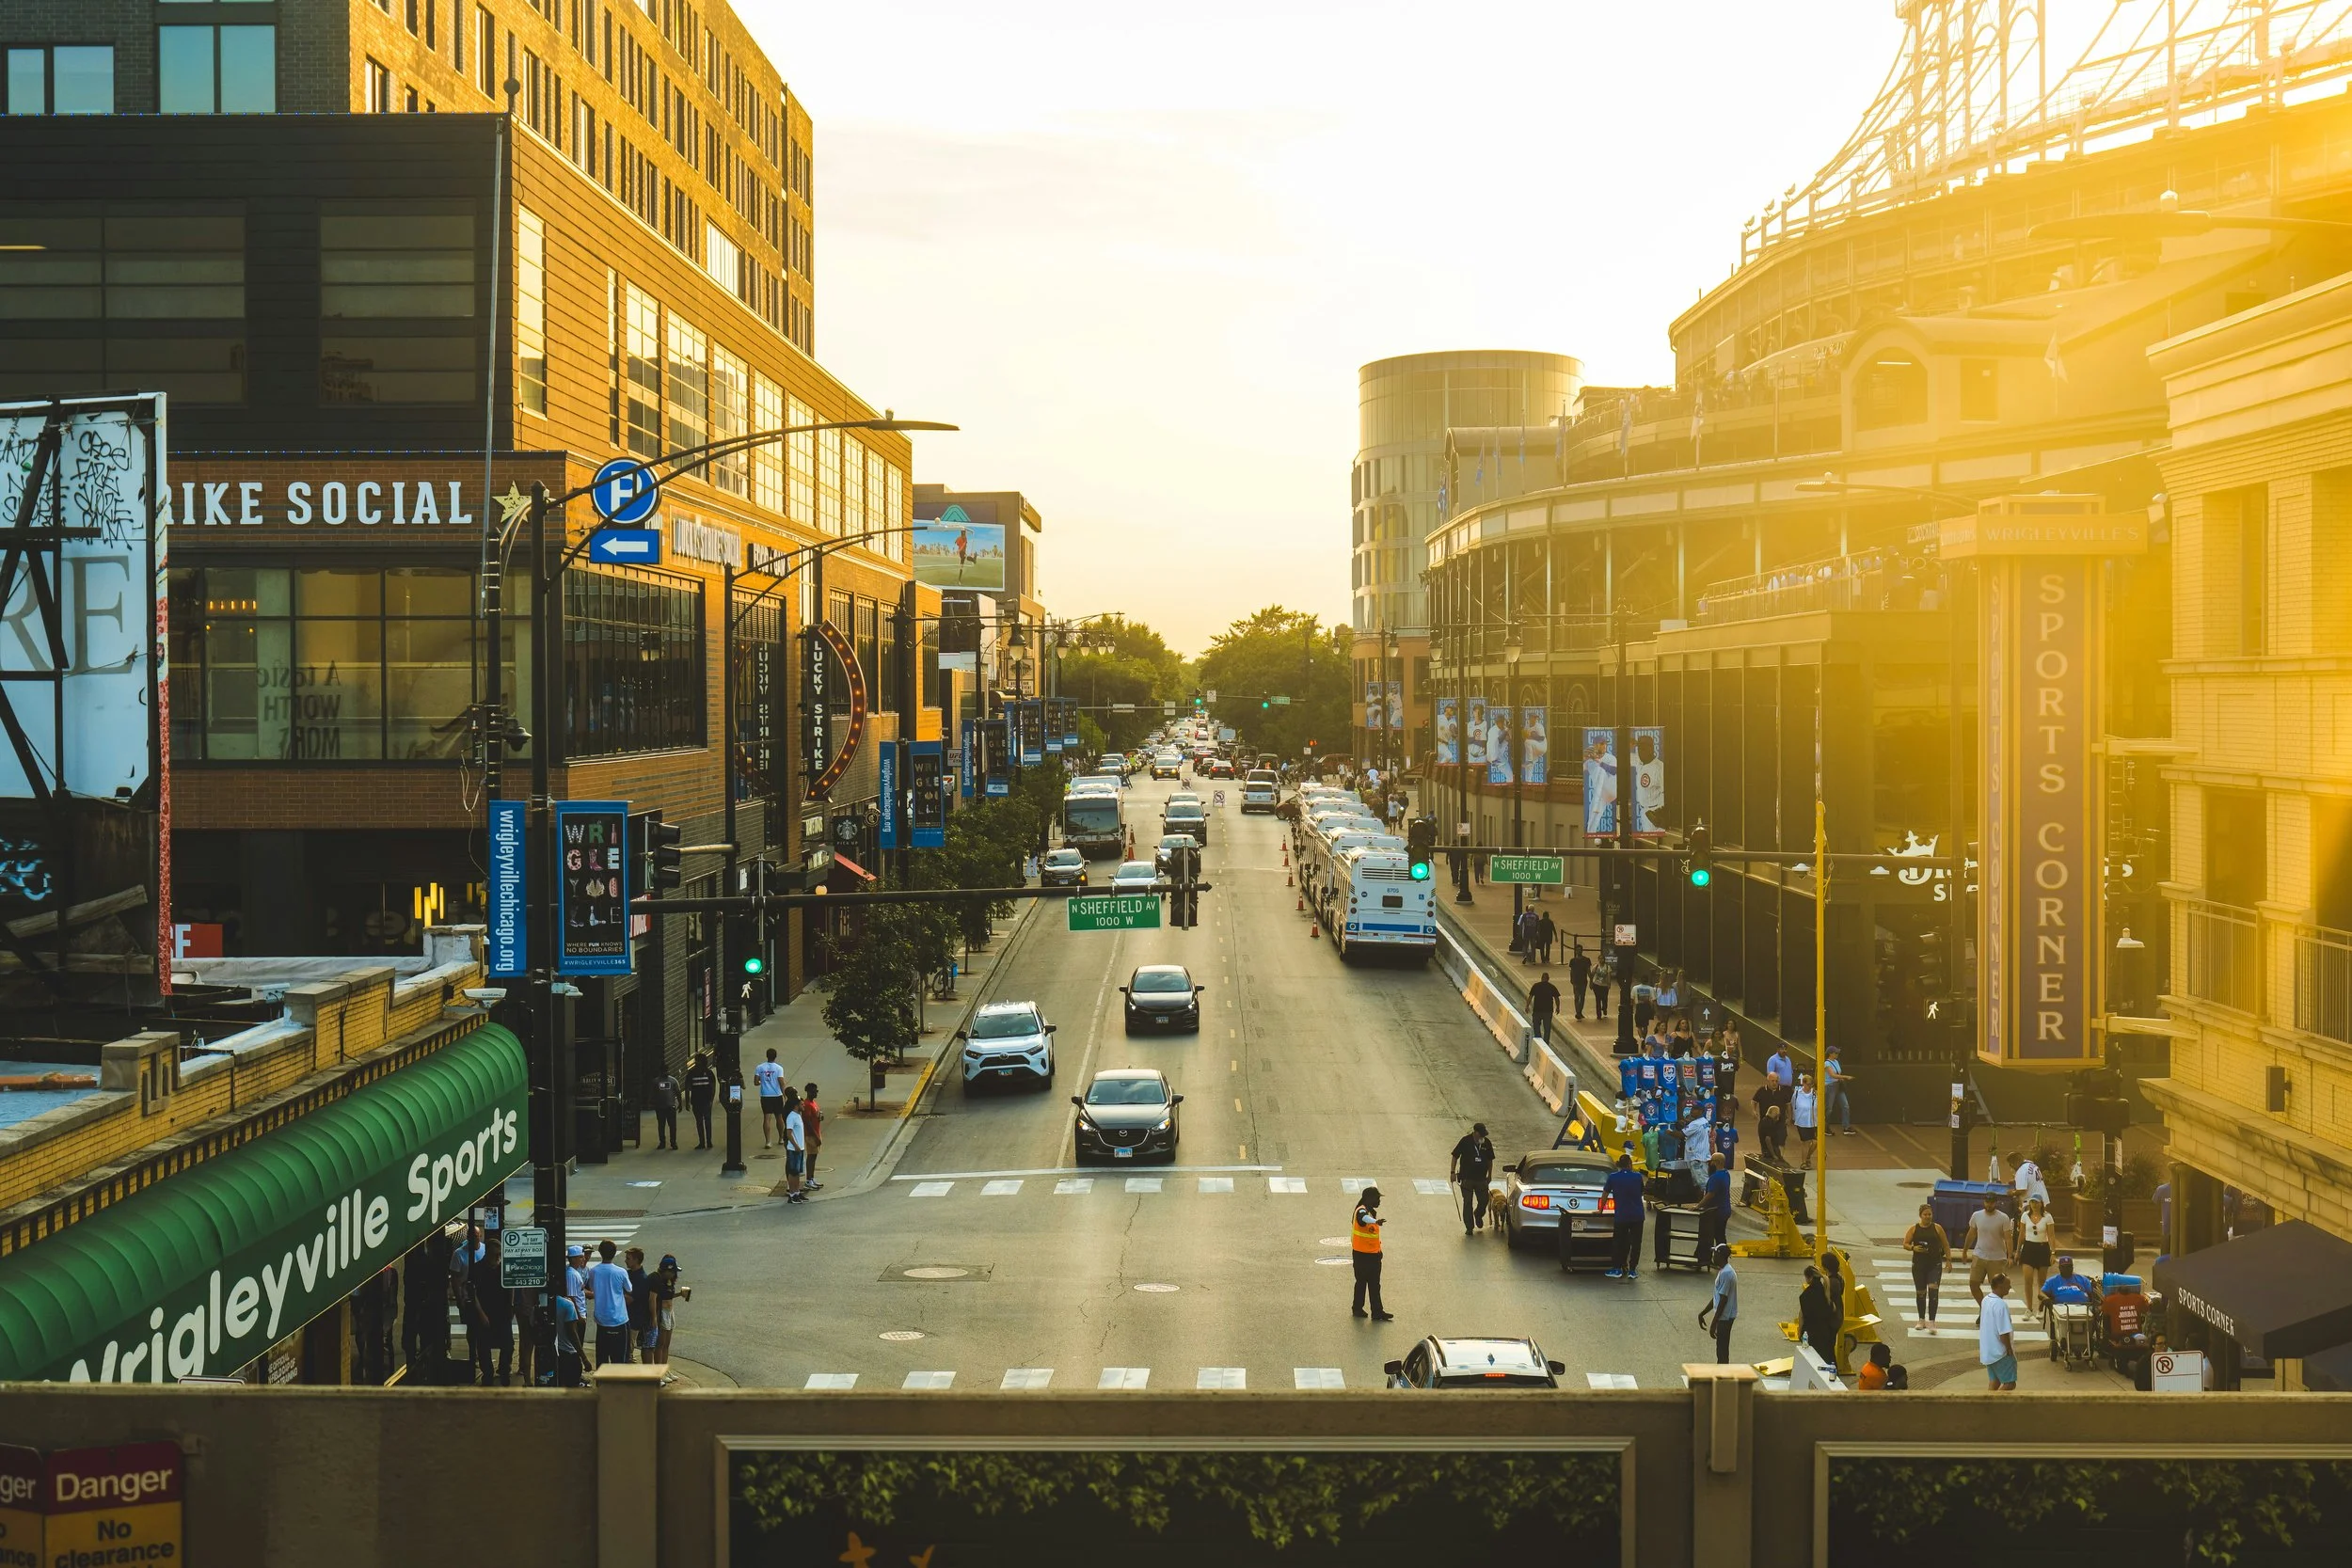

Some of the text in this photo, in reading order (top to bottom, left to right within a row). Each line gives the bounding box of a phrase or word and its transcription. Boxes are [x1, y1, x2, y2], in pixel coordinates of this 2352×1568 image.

[287, 482, 472, 525] SOCIAL
[1986, 527, 2138, 541] WRIGLEYVILLE'S
[813, 641, 823, 770] LUCKY STRIKE
[2035, 575, 2068, 1041] SPORTS CORNER
[1501, 860, 1549, 871] SHEFFIELD
[496, 810, 519, 972] wrigleyvillechicago.org
[1072, 900, 1155, 914] N SHEFFIELD AV
[1096, 916, 1134, 926] 1000 W
[407, 1107, 517, 1224] Sports
[2179, 1287, 2234, 1337] SPORTS CORNER
[56, 1469, 172, 1501] Danger
[98, 1520, 132, 1542] No
[55, 1542, 175, 1568] clearance
